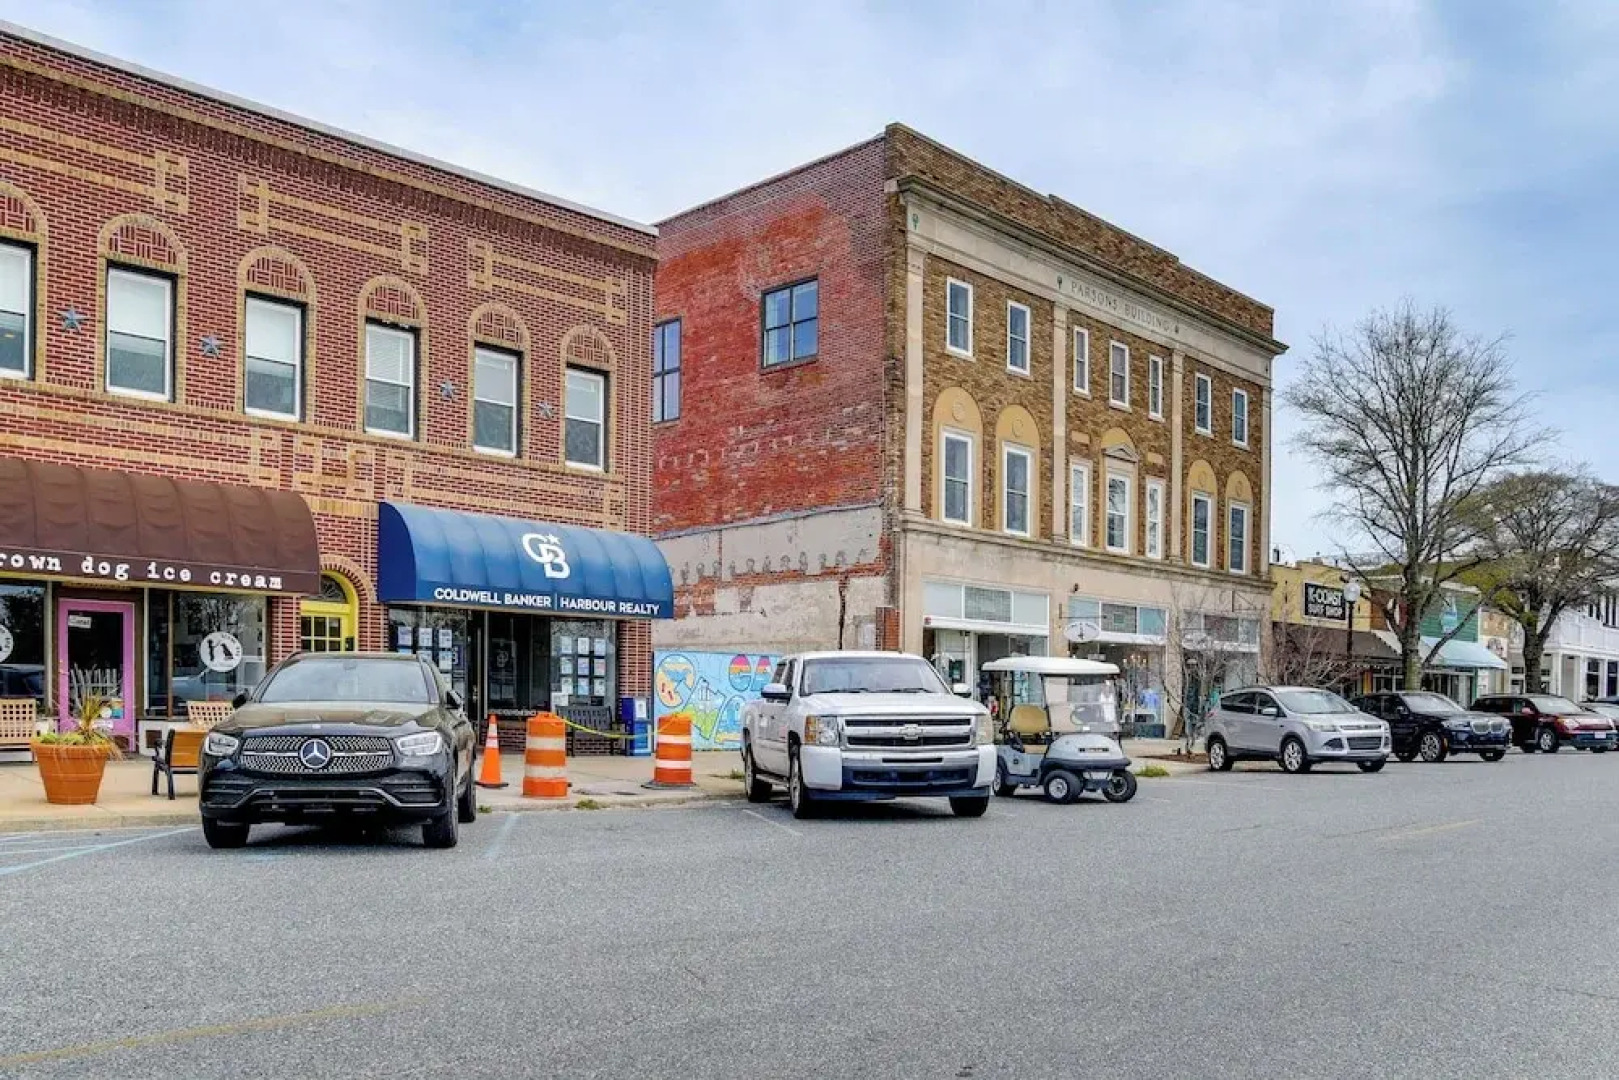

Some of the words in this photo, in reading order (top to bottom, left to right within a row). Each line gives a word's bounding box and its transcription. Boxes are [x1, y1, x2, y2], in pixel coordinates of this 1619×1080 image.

[1071, 281, 1118, 312] PARSONS
[1124, 303, 1170, 332] BUILDING
[81, 556, 130, 581] dog
[147, 561, 192, 582] ice
[210, 571, 283, 589] cream
[434, 587, 503, 604] COLDWELL
[504, 593, 552, 608] BANKER
[560, 596, 616, 612] HARBOUR
[619, 601, 660, 616] REALTY
